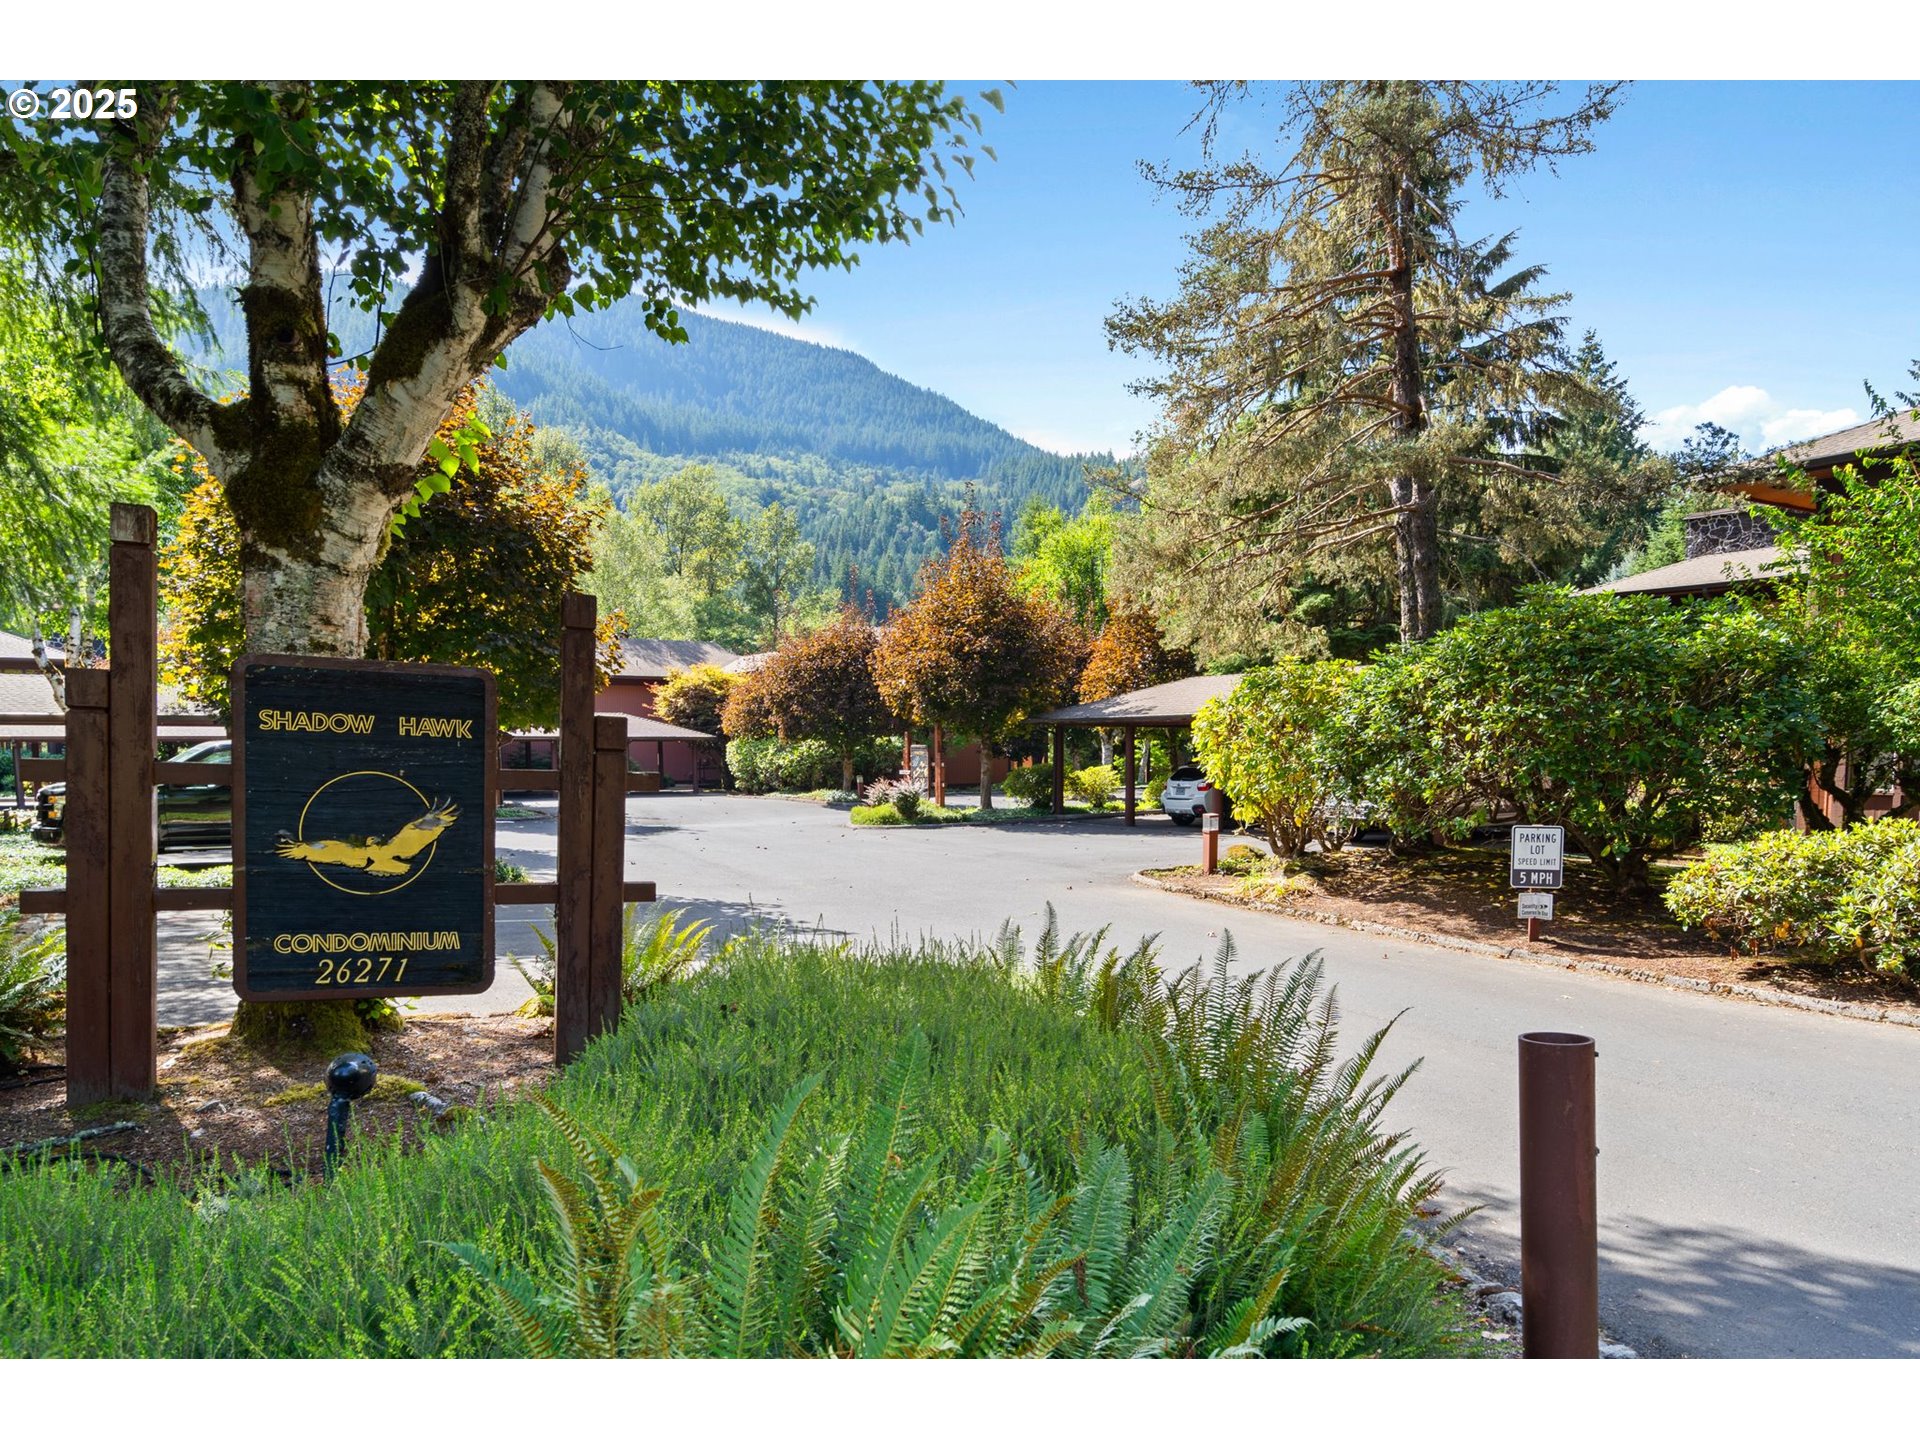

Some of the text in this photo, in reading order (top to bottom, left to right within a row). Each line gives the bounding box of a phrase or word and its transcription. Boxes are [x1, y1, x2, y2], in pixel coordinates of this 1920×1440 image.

[258, 709, 473, 739] SHADOW HAWK
[1519, 833, 1557, 843] PARKING
[1530, 845, 1545, 855] LOT
[1517, 858, 1556, 866] SPEED LIMIT
[1520, 871, 1553, 884] 5 MPH
[274, 931, 460, 953] CONDOMINIUM
[315, 957, 409, 985] 26271
